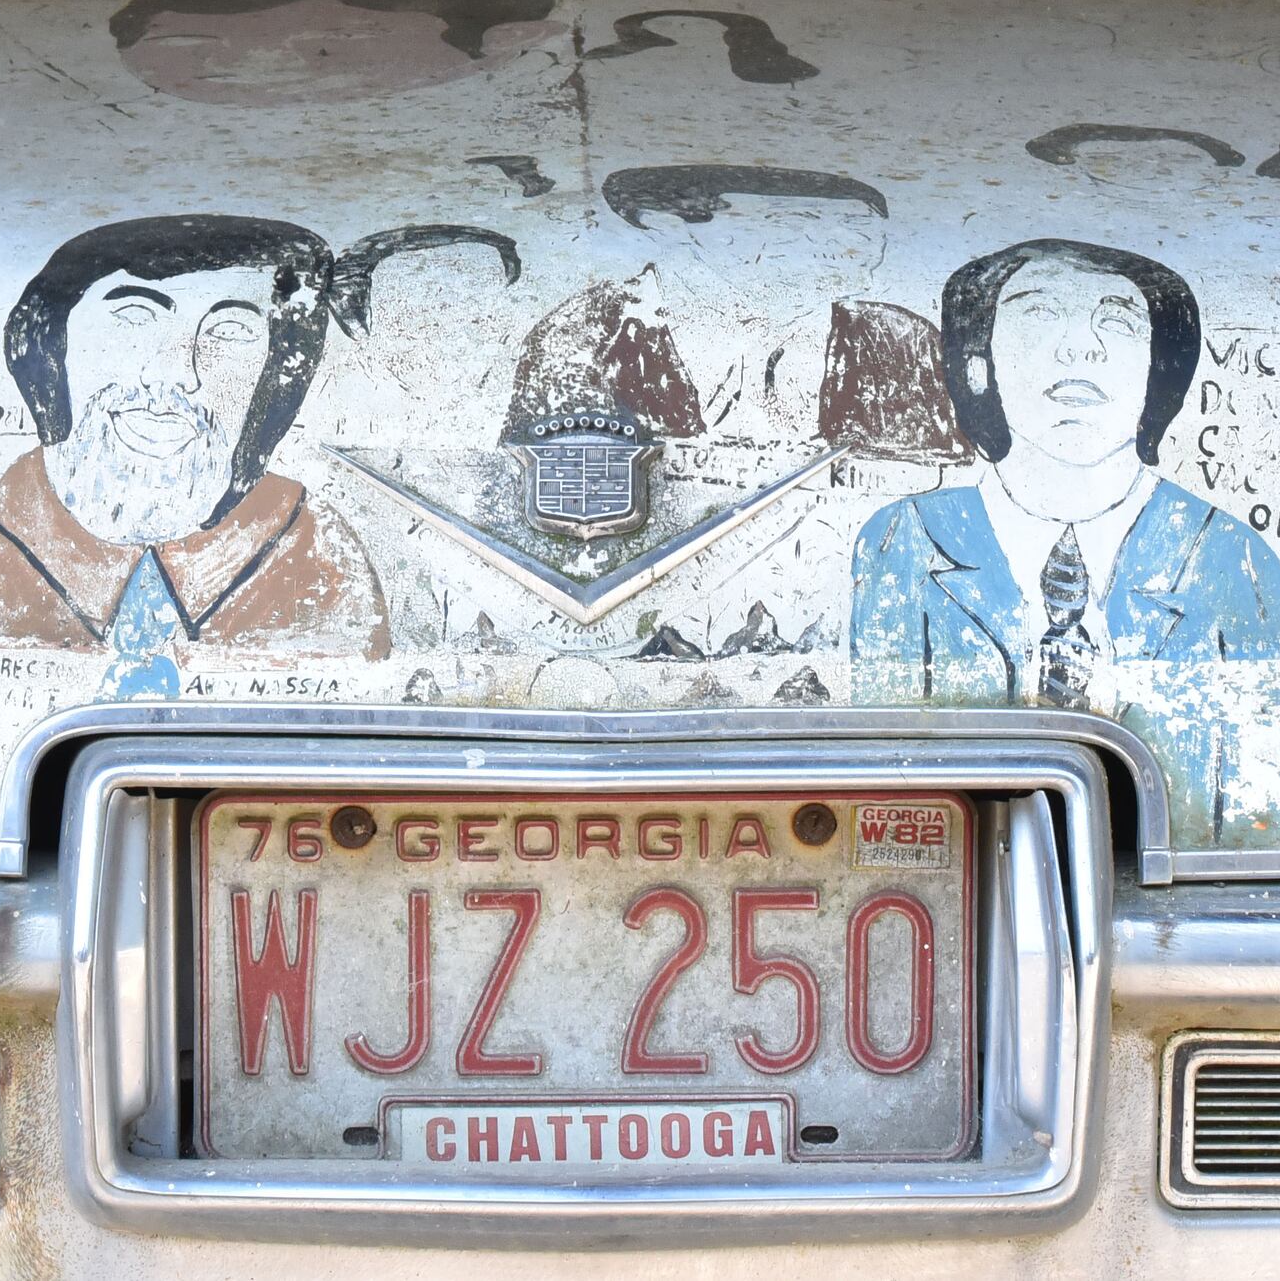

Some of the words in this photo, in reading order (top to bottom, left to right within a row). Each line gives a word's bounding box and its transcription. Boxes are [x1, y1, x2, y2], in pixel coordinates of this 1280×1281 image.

[862, 808, 945, 824] GEORGIA
[238, 814, 324, 862] 76
[395, 816, 772, 862] GEORGIA
[894, 823, 945, 846] 82
[426, 1108, 776, 1164] CHATTOOGA
